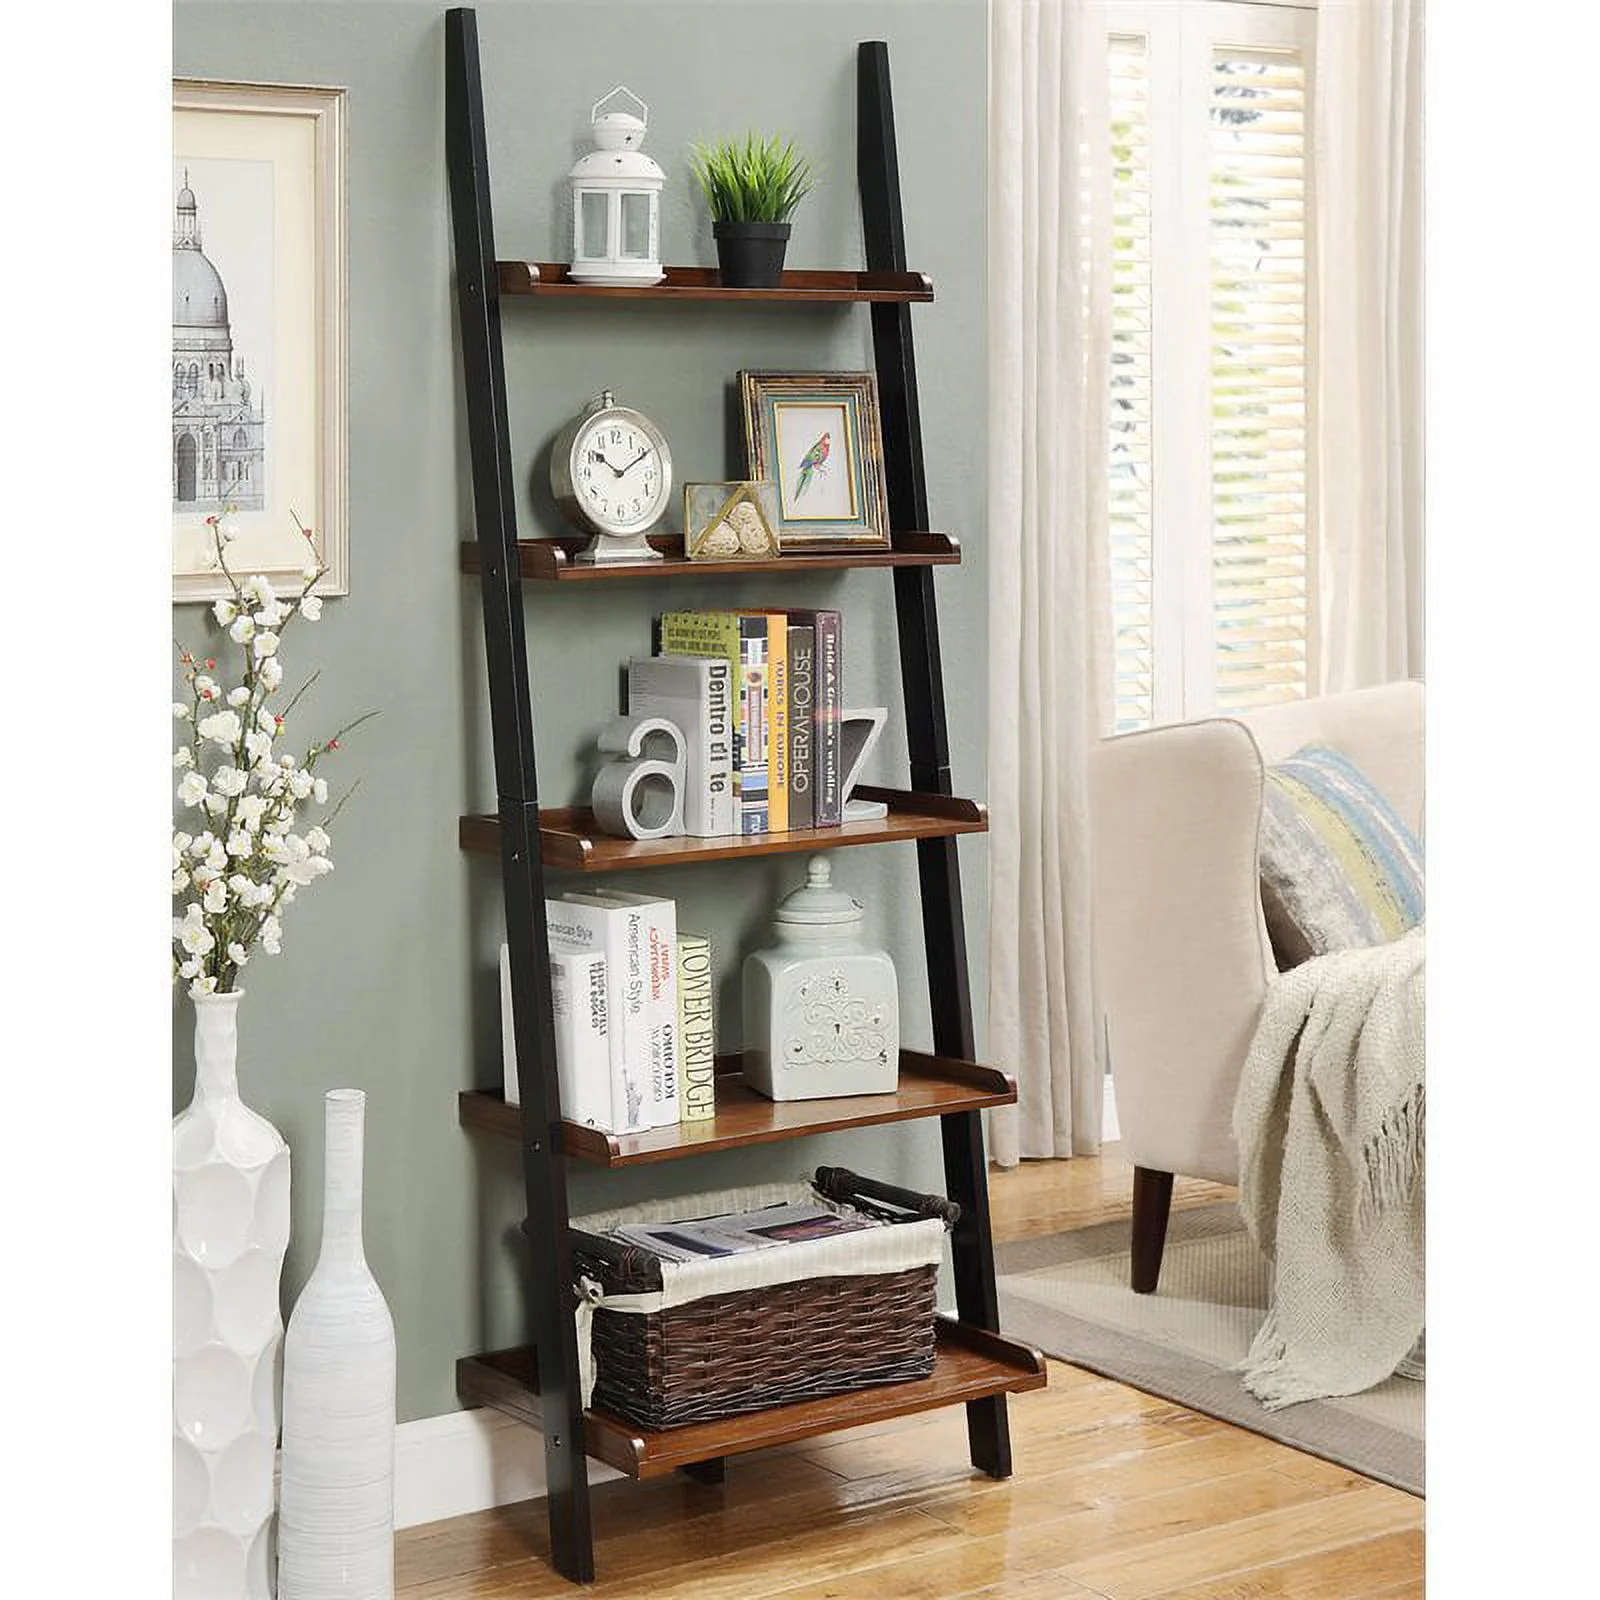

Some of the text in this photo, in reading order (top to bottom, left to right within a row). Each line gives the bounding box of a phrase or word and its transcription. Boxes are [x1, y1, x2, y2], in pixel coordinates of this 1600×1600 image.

[610, 430, 622, 445] 12
[708, 665, 728, 793] Dentro di te
[776, 733, 785, 789] EUROPE
[626, 913, 643, 1015] American Style
[682, 942, 713, 1117] TOWER BRIDGE
